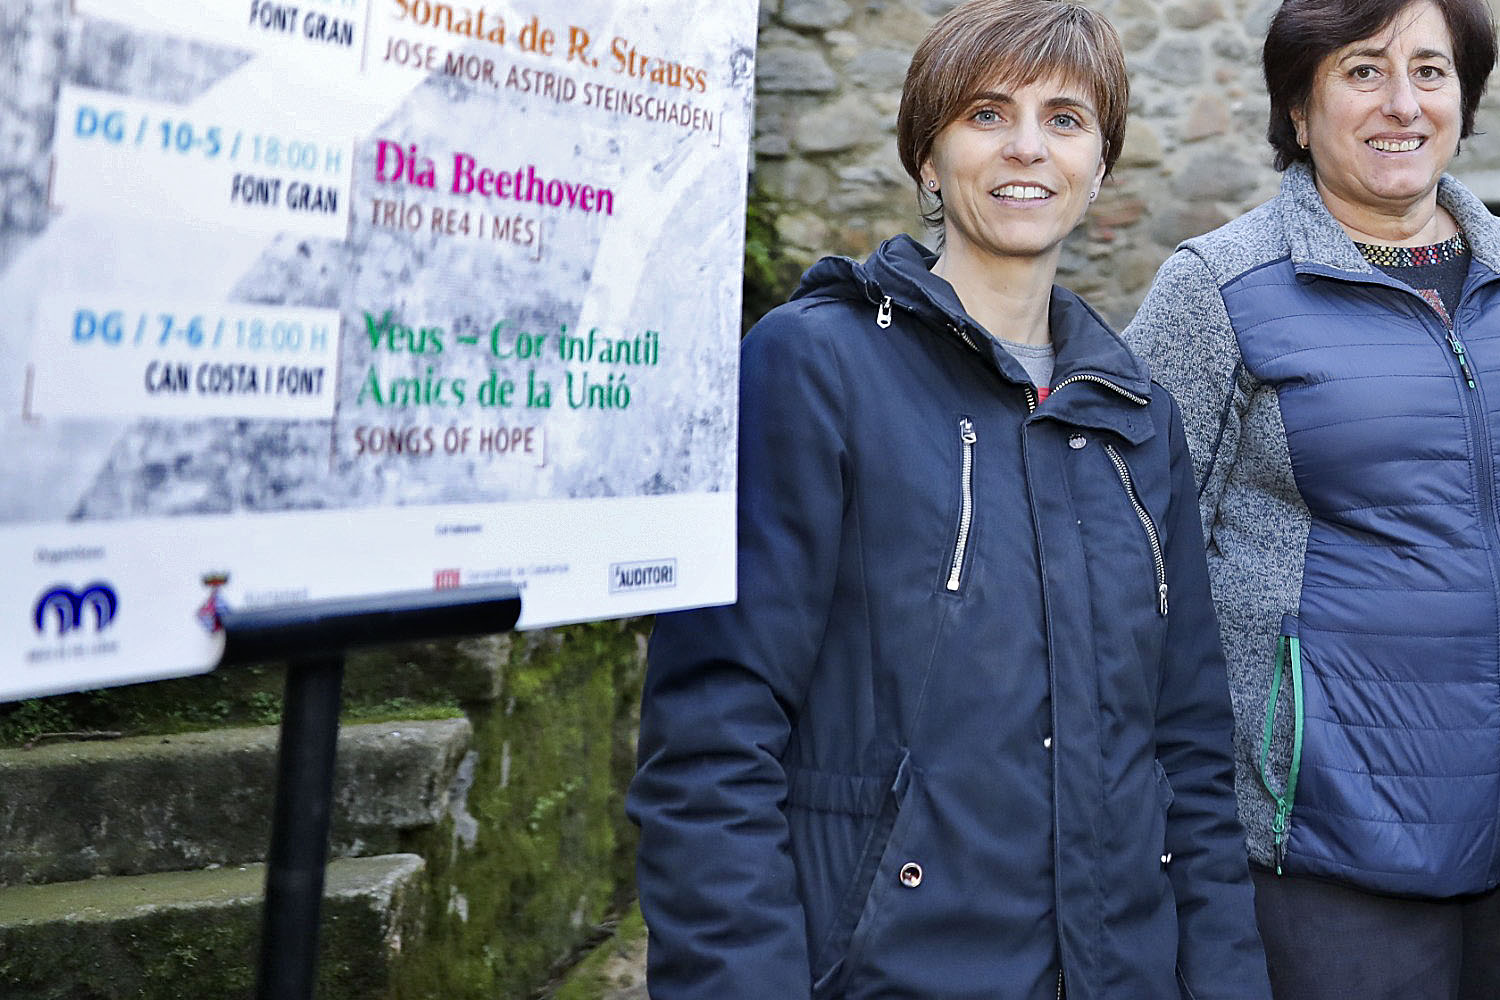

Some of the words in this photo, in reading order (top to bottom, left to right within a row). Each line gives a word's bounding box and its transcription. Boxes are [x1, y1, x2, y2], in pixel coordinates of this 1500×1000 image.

[302, 10, 355, 48] GRAN
[517, 13, 556, 57] de
[566, 24, 600, 70] R.
[610, 36, 709, 95] Strauss
[444, 51, 500, 90] MOR,
[505, 63, 577, 104] ASTRID
[583, 81, 714, 133] STEINSCHADEN
[74, 104, 125, 145] DG
[159, 119, 222, 158] 10-5
[325, 147, 343, 175] H
[231, 172, 282, 206] FONT
[286, 181, 339, 215] GRAN
[374, 137, 436, 190] Dia
[451, 151, 616, 217] Beethoven
[430, 206, 472, 237] RE4
[492, 213, 536, 247] MÉS
[73, 306, 124, 346] DG
[156, 313, 205, 348] 7-6
[309, 323, 328, 352] H
[363, 310, 445, 357] Veus
[490, 318, 549, 359] Cor
[560, 323, 660, 366] infantil
[144, 358, 190, 393] CAN
[196, 361, 259, 394] COSTA
[276, 364, 326, 396] FONT
[357, 364, 466, 409] Amics
[477, 369, 516, 409] de
[526, 369, 553, 409] la
[565, 370, 632, 411] Unió
[353, 425, 436, 458] SONGS
[442, 425, 473, 456] OF
[479, 425, 537, 455] HOPE
